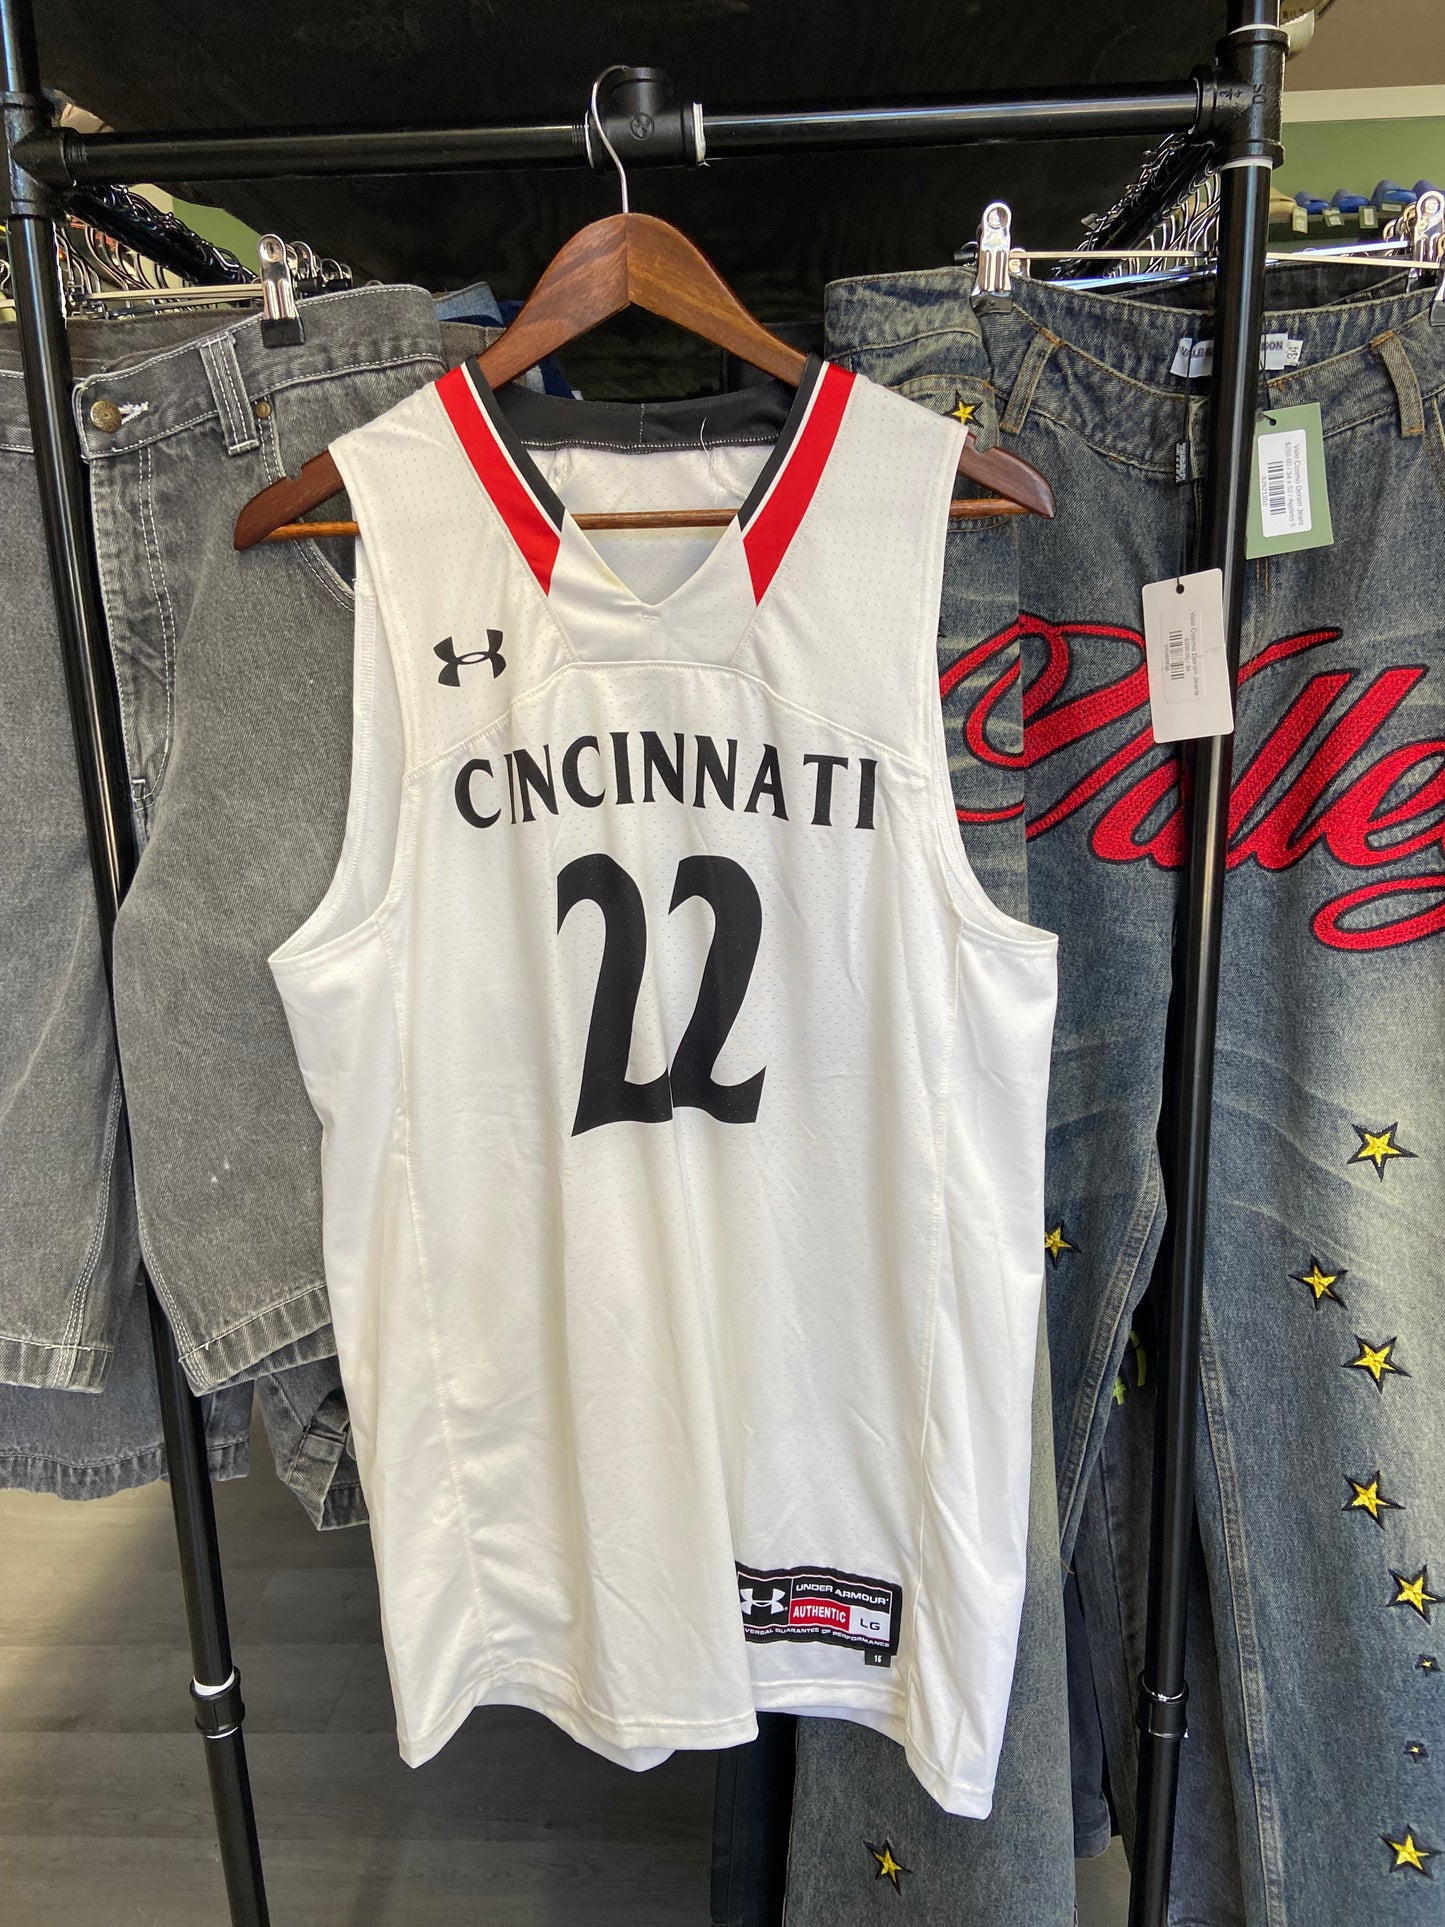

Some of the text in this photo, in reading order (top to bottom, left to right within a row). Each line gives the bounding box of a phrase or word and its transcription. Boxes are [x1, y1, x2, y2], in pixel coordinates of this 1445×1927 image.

[1286, 346, 1299, 360] 34
[454, 730, 878, 830] CINCINNATI
[556, 853, 767, 1137] 22
[795, 1584, 886, 1605] UNDER ARMOUR
[792, 1605, 847, 1623] AUTHENTIC
[860, 1617, 881, 1631] LG
[744, 1627, 774, 1636] VERSAL
[775, 1627, 820, 1635] GUARANTEE
[832, 1631, 890, 1648] PERFORMANCE
